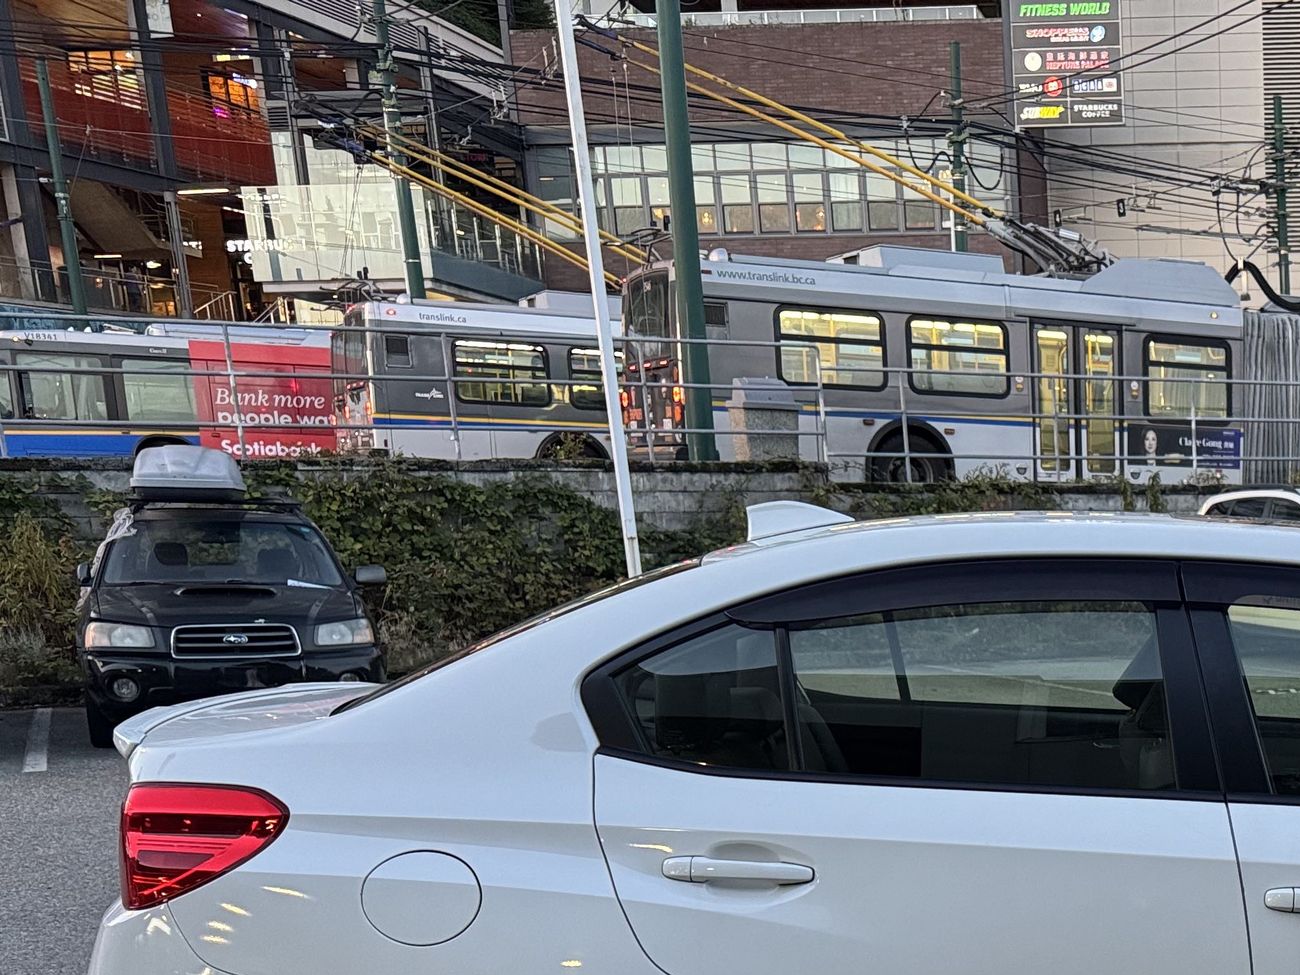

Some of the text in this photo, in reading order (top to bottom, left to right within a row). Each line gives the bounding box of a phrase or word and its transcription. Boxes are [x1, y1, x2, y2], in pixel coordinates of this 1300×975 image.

[1019, 2, 1110, 17] FITNESS WORLD
[1025, 27, 1089, 37] SHOPPERS
[1020, 105, 1065, 120] SUBWAY
[1073, 104, 1118, 112] STARBUCKS
[716, 269, 816, 286] www.translink.bc.ca
[418, 312, 467, 323] translink.ca
[215, 388, 325, 409] Bank more
[218, 410, 333, 427] people wa
